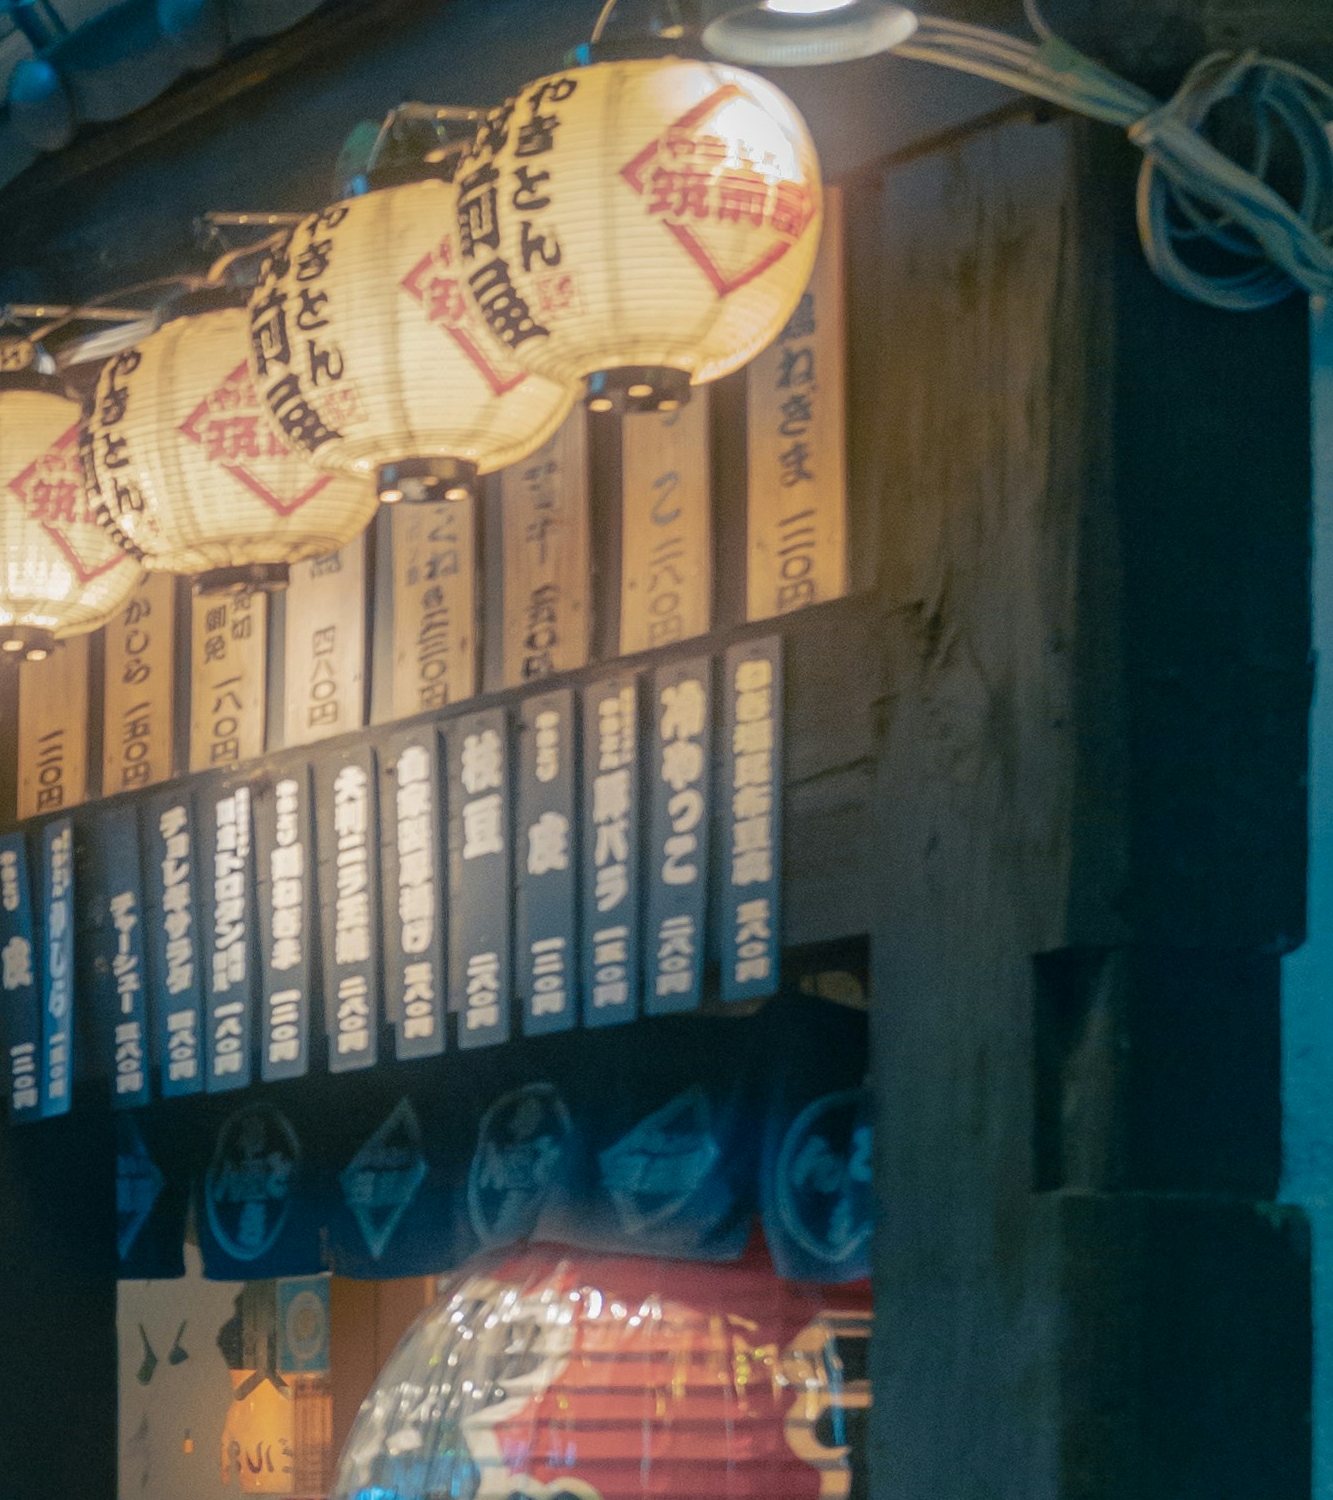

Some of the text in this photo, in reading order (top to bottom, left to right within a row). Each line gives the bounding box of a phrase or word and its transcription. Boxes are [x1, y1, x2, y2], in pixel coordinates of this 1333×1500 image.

[513, 77, 578, 274] やきとん
[290, 206, 349, 386] やきとん
[208, 674, 244, 766] 一八〇円
[308, 624, 339, 730] 四八〇円
